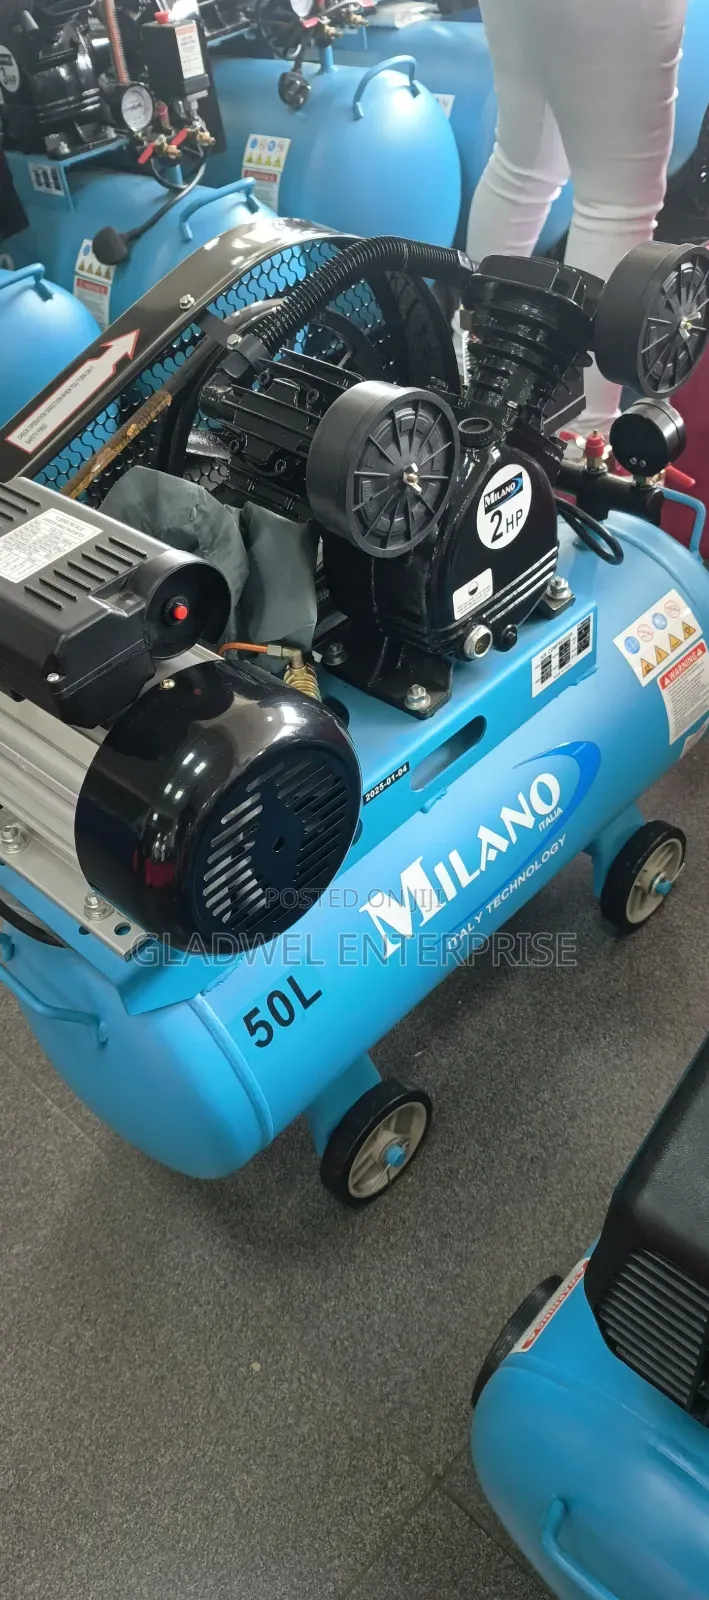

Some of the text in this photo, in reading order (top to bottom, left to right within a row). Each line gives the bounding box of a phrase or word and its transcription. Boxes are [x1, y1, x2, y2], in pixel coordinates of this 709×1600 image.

[17, 428, 29, 440] CHECK
[28, 411, 47, 430] OPERATION
[45, 397, 62, 413] DIRECTION
[62, 388, 72, 398] WHEN
[70, 381, 79, 389] YOU
[76, 373, 86, 382] TURN
[25, 422, 47, 445] SAFETY FIRST
[484, 481, 516, 508] MILANO
[490, 508, 523, 544] 2 HP
[668, 654, 697, 682] WARNING
[365, 765, 408, 802] 2025-01-04
[538, 807, 563, 832] ITALIA
[358, 772, 561, 960] MILANO
[448, 834, 567, 950] ITALY TECHNOLOGY
[242, 973, 323, 1049] 50L
